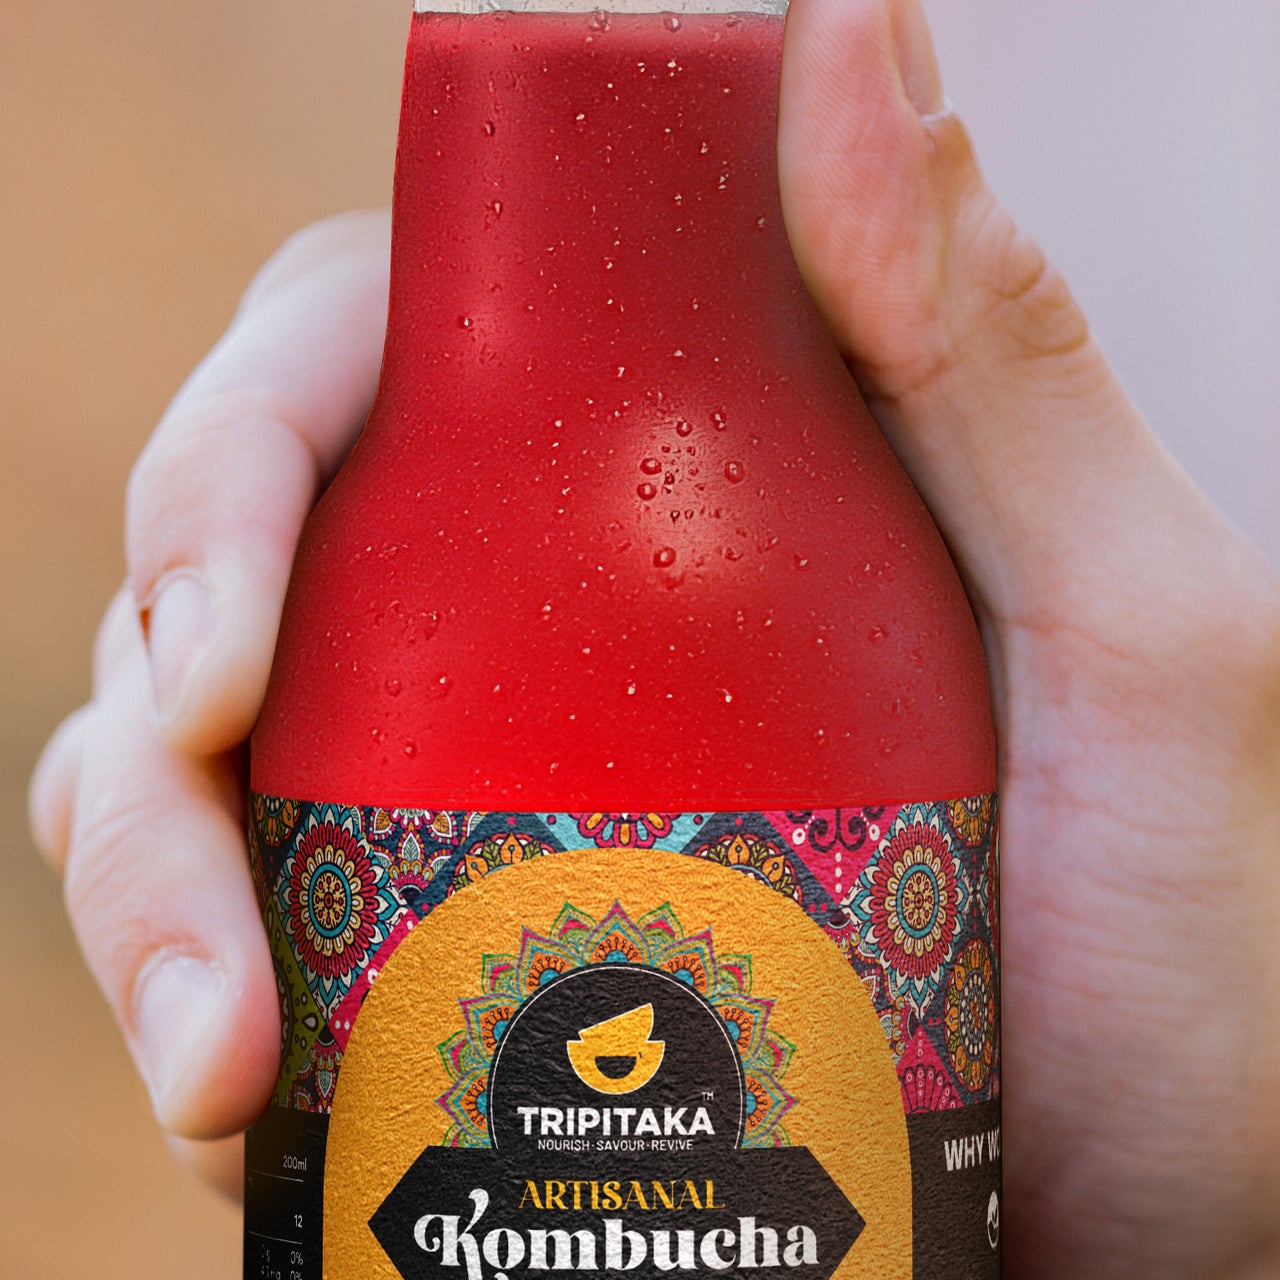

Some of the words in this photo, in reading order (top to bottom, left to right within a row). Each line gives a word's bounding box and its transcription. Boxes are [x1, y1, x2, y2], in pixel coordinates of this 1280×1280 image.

[517, 1106, 716, 1136] TRIPITAKA
[538, 1139, 590, 1151] NOURISH
[596, 1139, 645, 1151] SAVOUR
[651, 1138, 694, 1151] REVIVE
[944, 1132, 984, 1172] WHY
[283, 1155, 307, 1172] 200ml
[518, 1179, 725, 1211] ARTISANAL
[294, 1214, 303, 1228] 12
[290, 1250, 303, 1266] 0%
